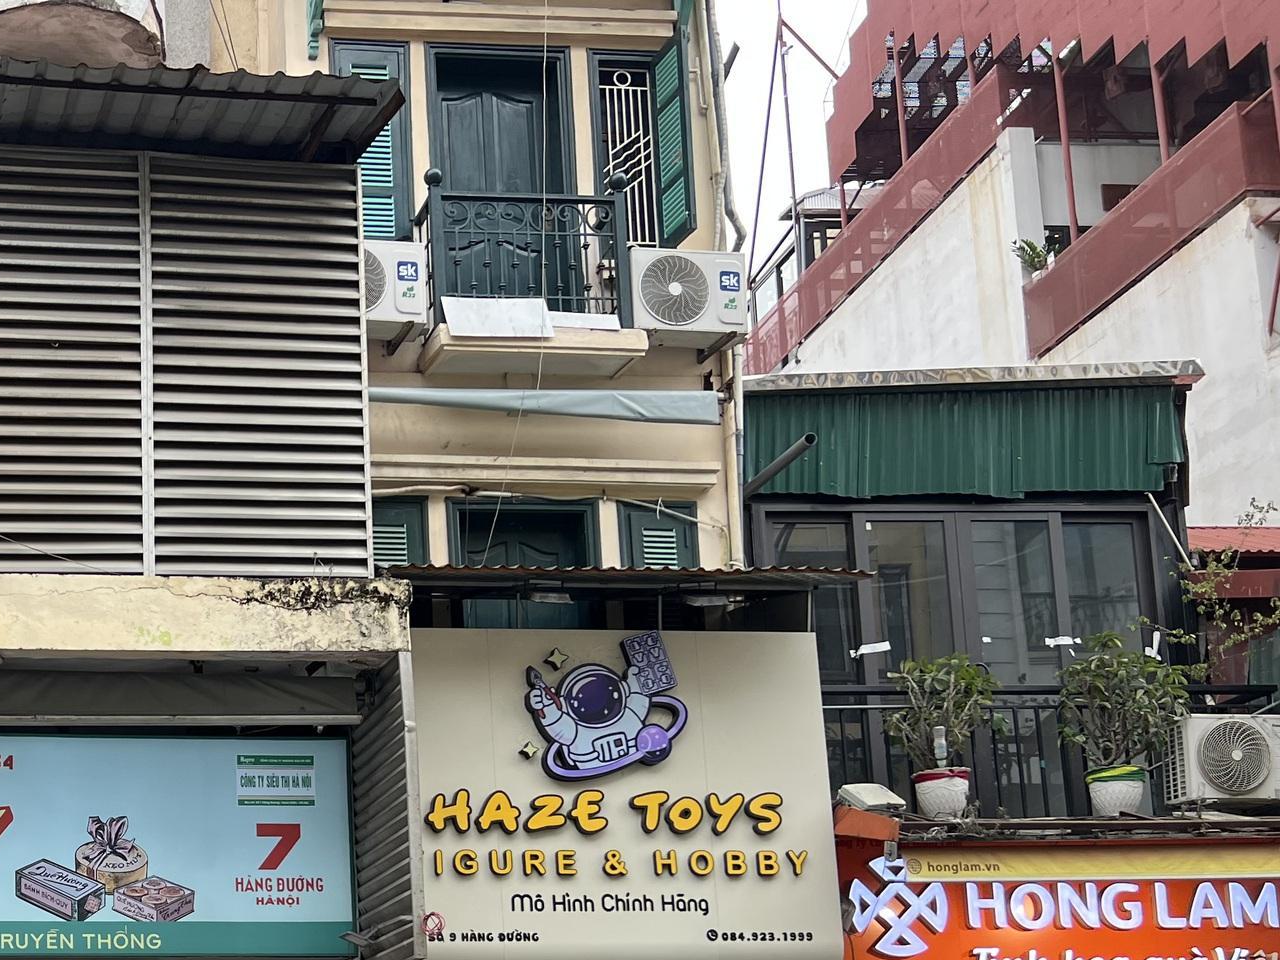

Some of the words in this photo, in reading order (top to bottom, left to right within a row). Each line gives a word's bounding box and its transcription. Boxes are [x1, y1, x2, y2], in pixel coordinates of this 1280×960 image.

[258, 775, 264, 788] TY
[425, 788, 609, 835] HAZE
[630, 790, 784, 835] TOYS
[256, 823, 301, 870] 7
[603, 849, 628, 877] &
[653, 848, 808, 877] HOBBY
[927, 860, 1001, 875] honglam.vn
[235, 875, 273, 892] HÀNG
[276, 875, 324, 892] ĐƯỜNG
[511, 893, 545, 912] Mô
[552, 892, 595, 912] Hình
[601, 892, 655, 912] Chính
[964, 881, 1144, 930] HONG
[1153, 881, 1280, 930] LAM
[448, 932, 457, 942] 9
[461, 929, 494, 942] HÀNG
[498, 929, 539, 942] ĐƯỜNG
[721, 931, 814, 942] 084.923.1999
